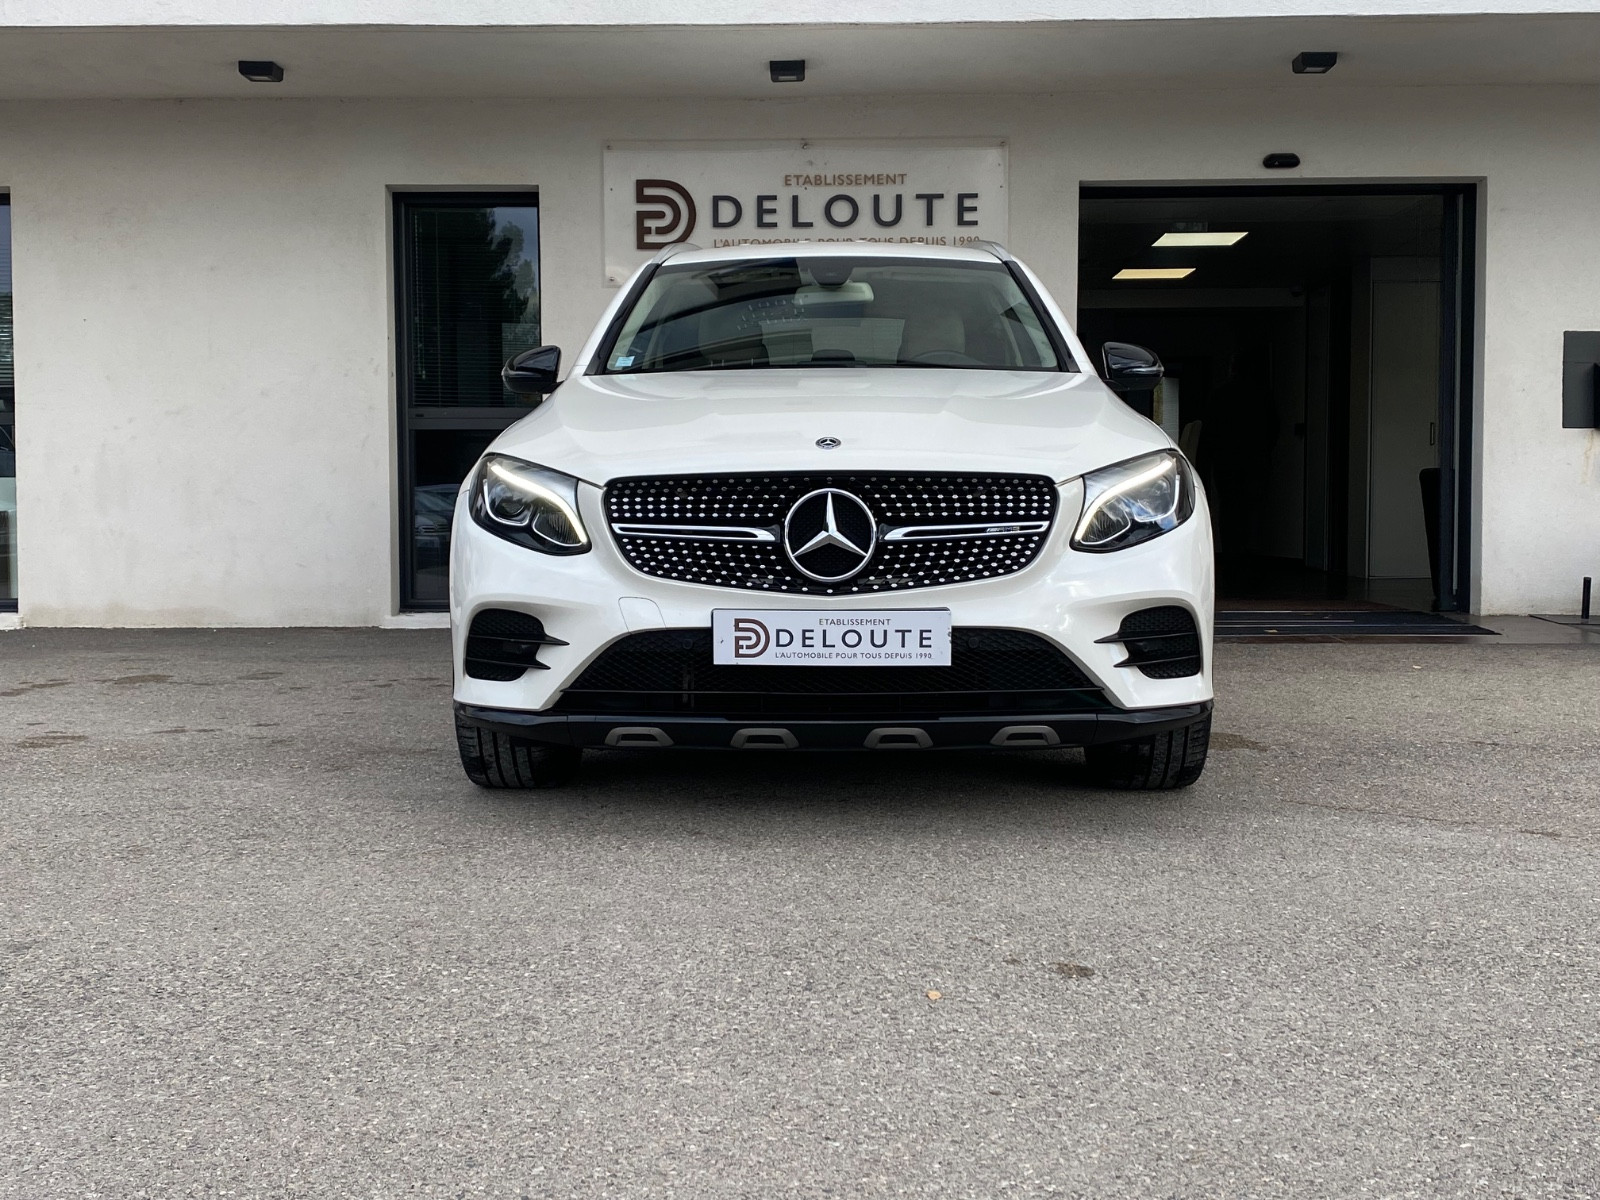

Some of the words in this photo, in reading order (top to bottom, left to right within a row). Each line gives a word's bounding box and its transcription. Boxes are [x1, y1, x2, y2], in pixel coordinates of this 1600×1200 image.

[784, 173, 908, 187] ETABLISSEMENT
[712, 192, 979, 229] DELOUTE
[713, 237, 812, 249] L'AUTOM
[819, 618, 892, 626] ETABLISSEMENT
[775, 628, 932, 648] DELOUTE
